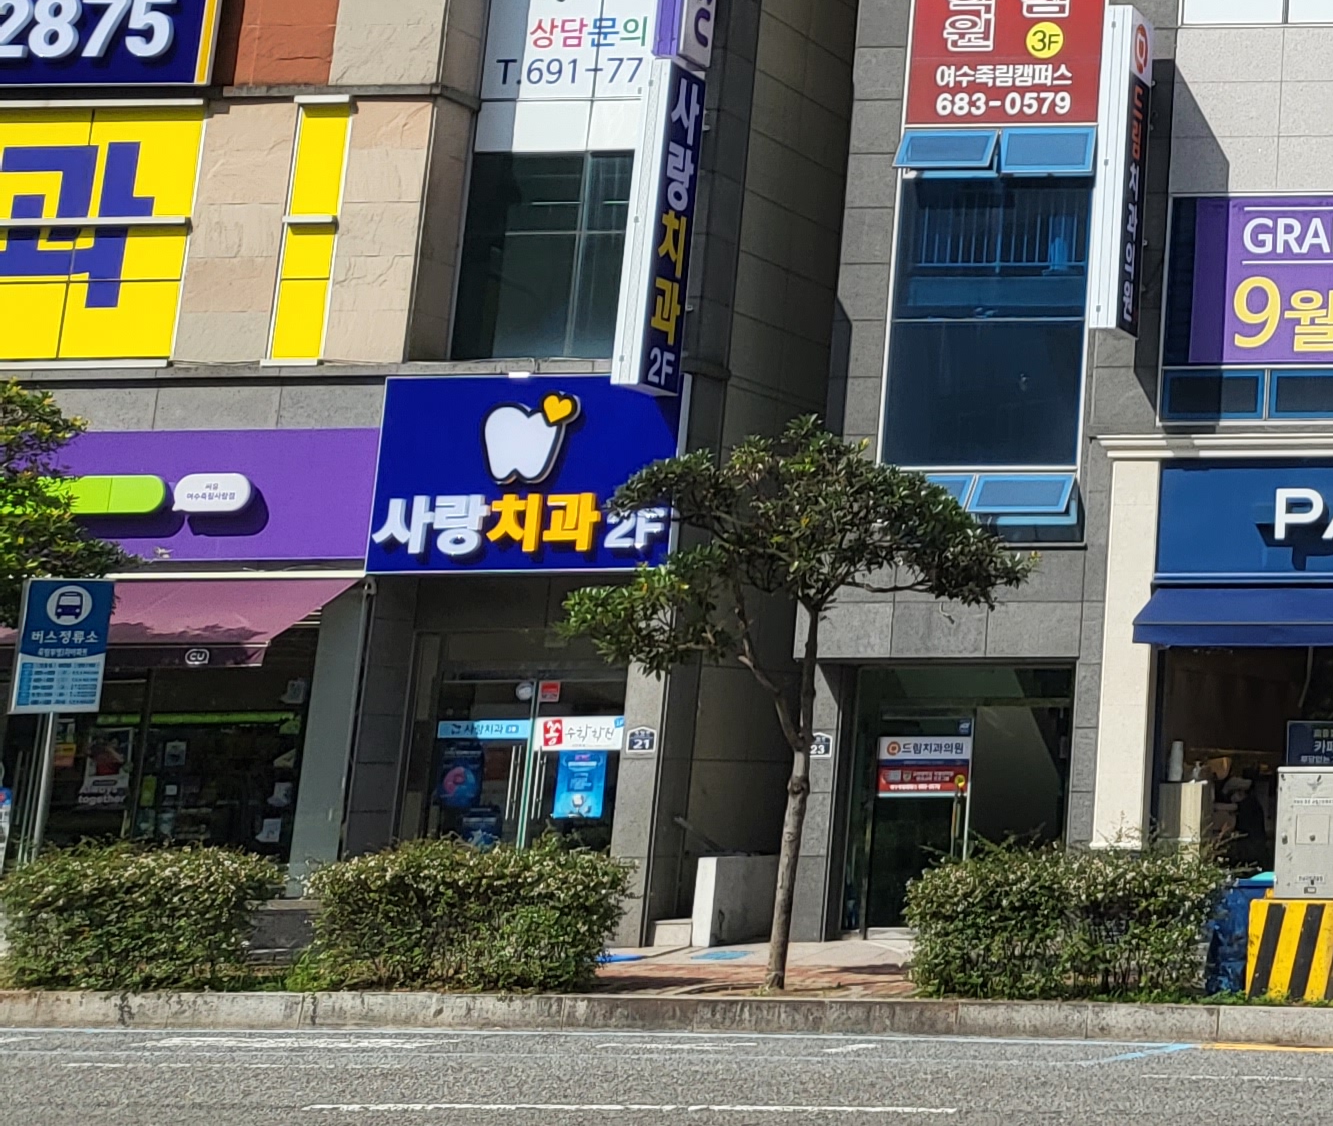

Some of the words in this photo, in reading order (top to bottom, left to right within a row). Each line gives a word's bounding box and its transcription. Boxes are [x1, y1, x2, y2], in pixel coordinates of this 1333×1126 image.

[530, 15, 648, 48] 상담문의
[1029, 29, 1061, 54] 3F
[935, 63, 1072, 87] 여수죽림캠퍼스
[935, 91, 1072, 116] 683-0579
[647, 348, 675, 385] 2F
[373, 492, 602, 556] 사랑치과
[603, 508, 664, 550] 2F
[31, 630, 98, 644] 버스정류소
[189, 651, 205, 661] CU
[633, 739, 650, 749] 21
